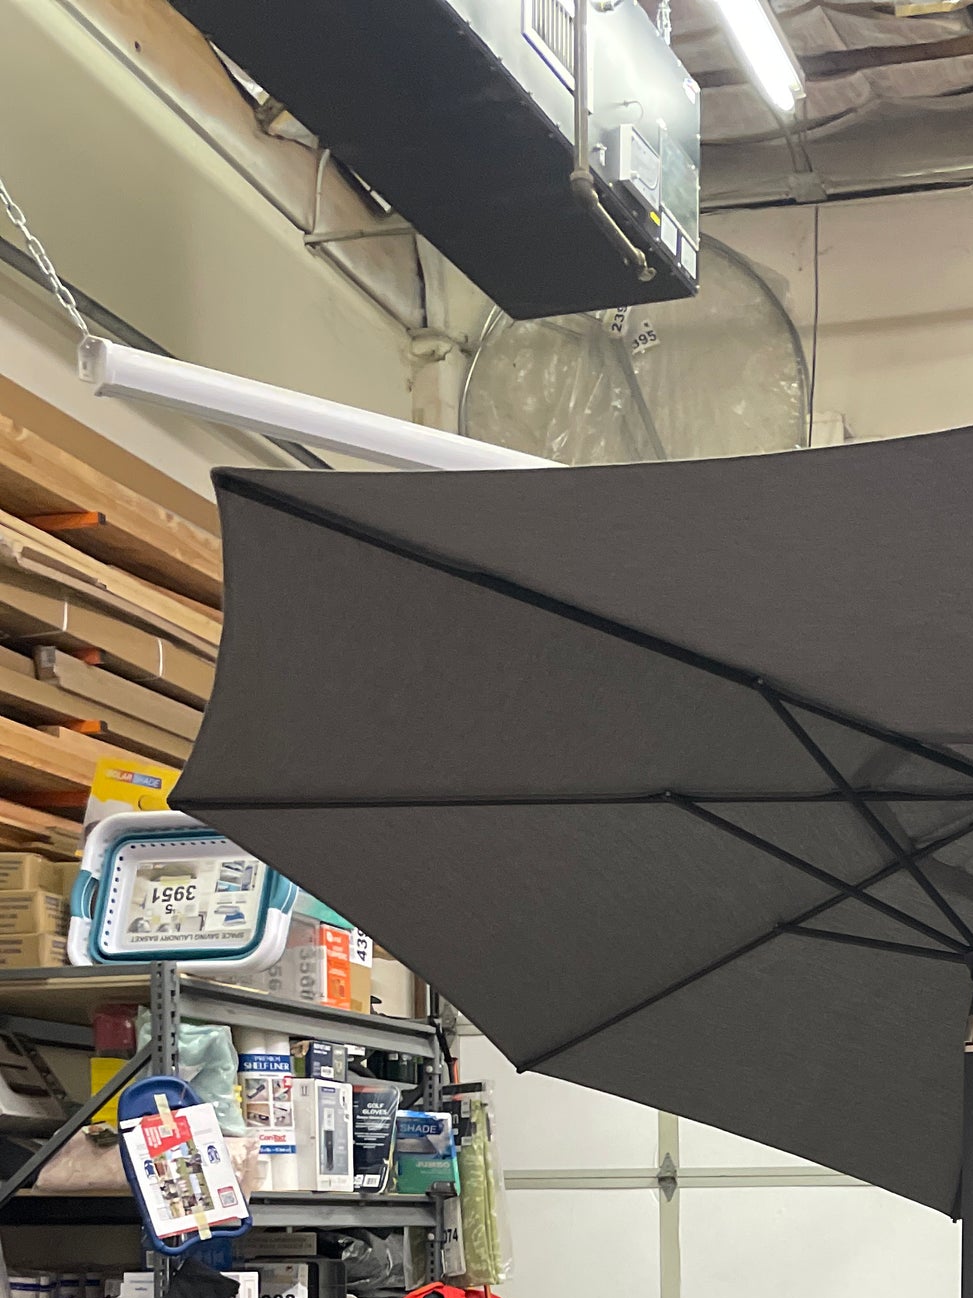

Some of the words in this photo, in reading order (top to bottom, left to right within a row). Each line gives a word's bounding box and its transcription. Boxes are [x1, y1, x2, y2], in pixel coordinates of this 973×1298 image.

[152, 885, 197, 904] 3951
[130, 935, 158, 944] BASKET
[159, 934, 194, 943] LAUNDRY
[221, 932, 245, 940] SPACE
[243, 1061, 269, 1070] SHELF
[269, 1062, 290, 1071] LINER
[399, 1122, 438, 1134] SHADE
